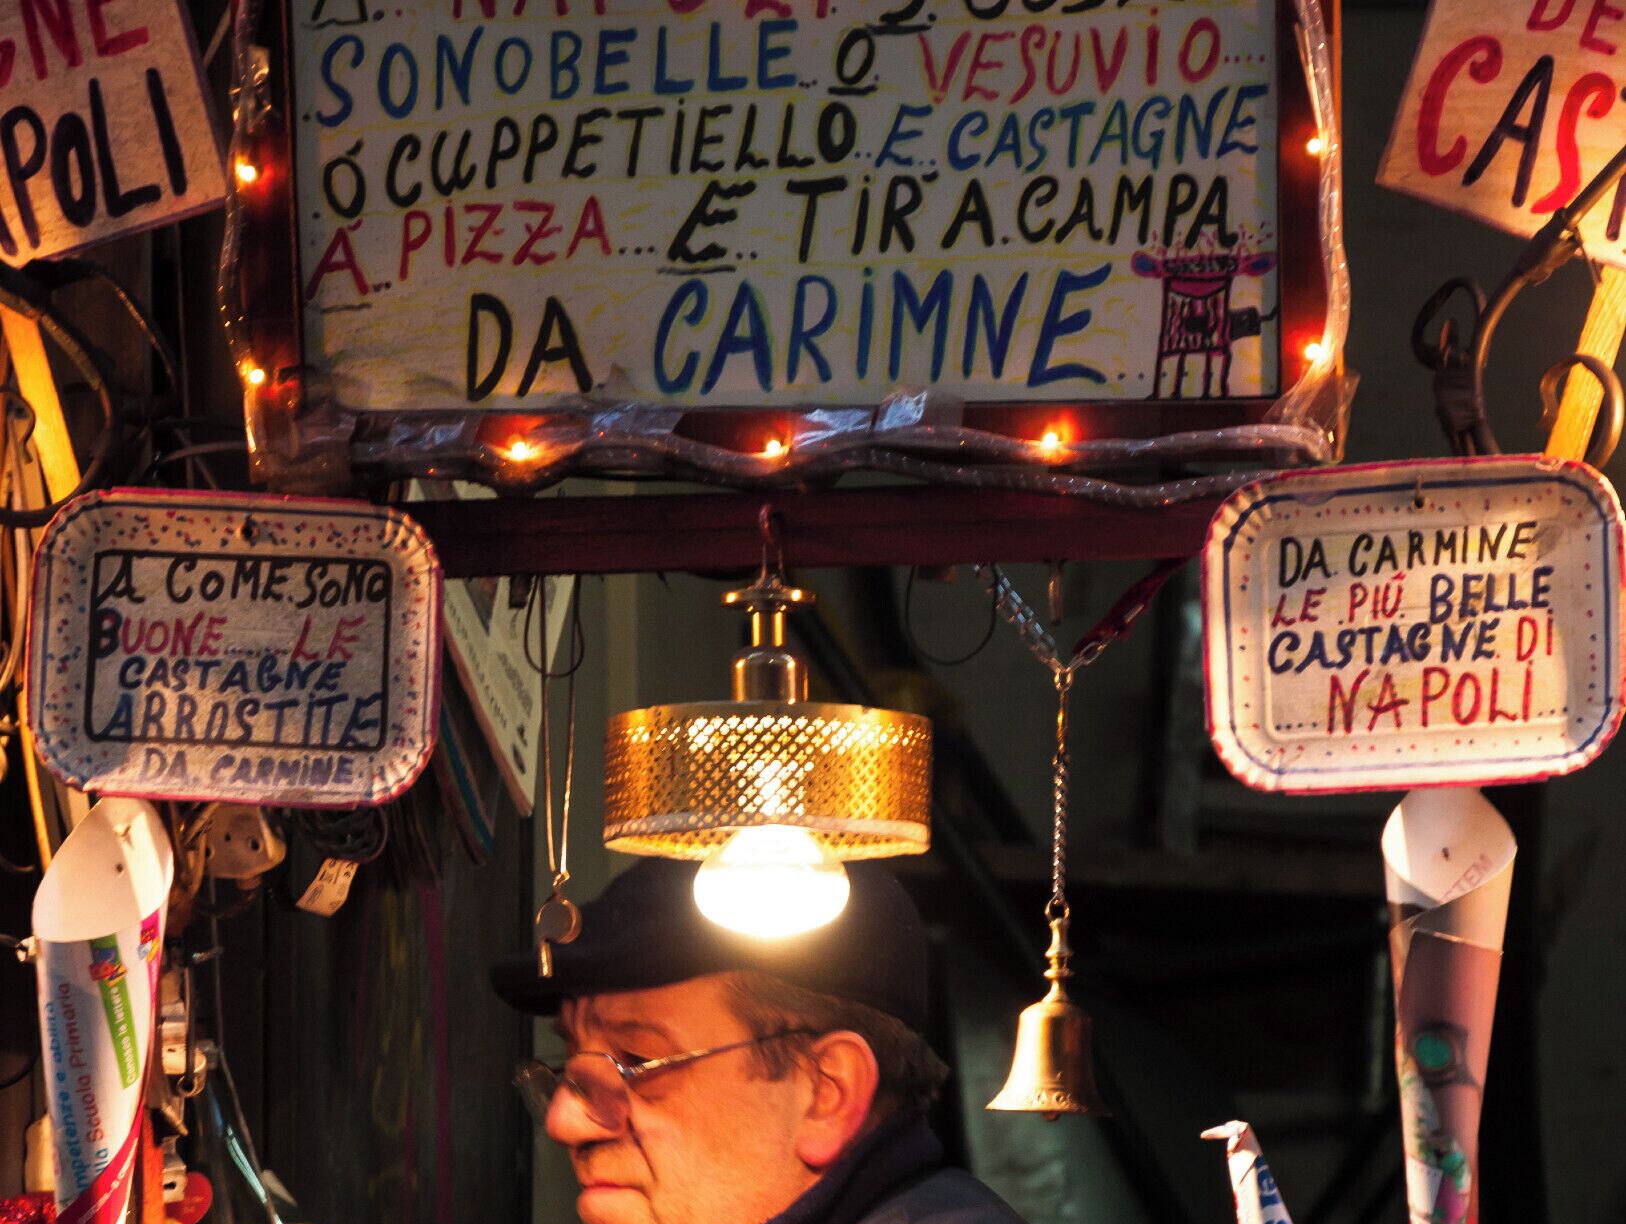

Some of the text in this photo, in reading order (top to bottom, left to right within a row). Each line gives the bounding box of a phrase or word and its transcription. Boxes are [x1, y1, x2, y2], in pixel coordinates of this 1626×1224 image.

[948, 84, 1269, 172] CASTAGNE
[0, 68, 188, 255] POLI
[1349, 521, 1538, 578] CARMINE
[1271, 587, 1328, 628] LE
[1429, 565, 1554, 625] BELLE
[290, 613, 365, 661] LE
[118, 655, 348, 694] CASTAGNE
[1327, 658, 1533, 735] NAPOLI
[98, 690, 383, 749] ARROSTITE
